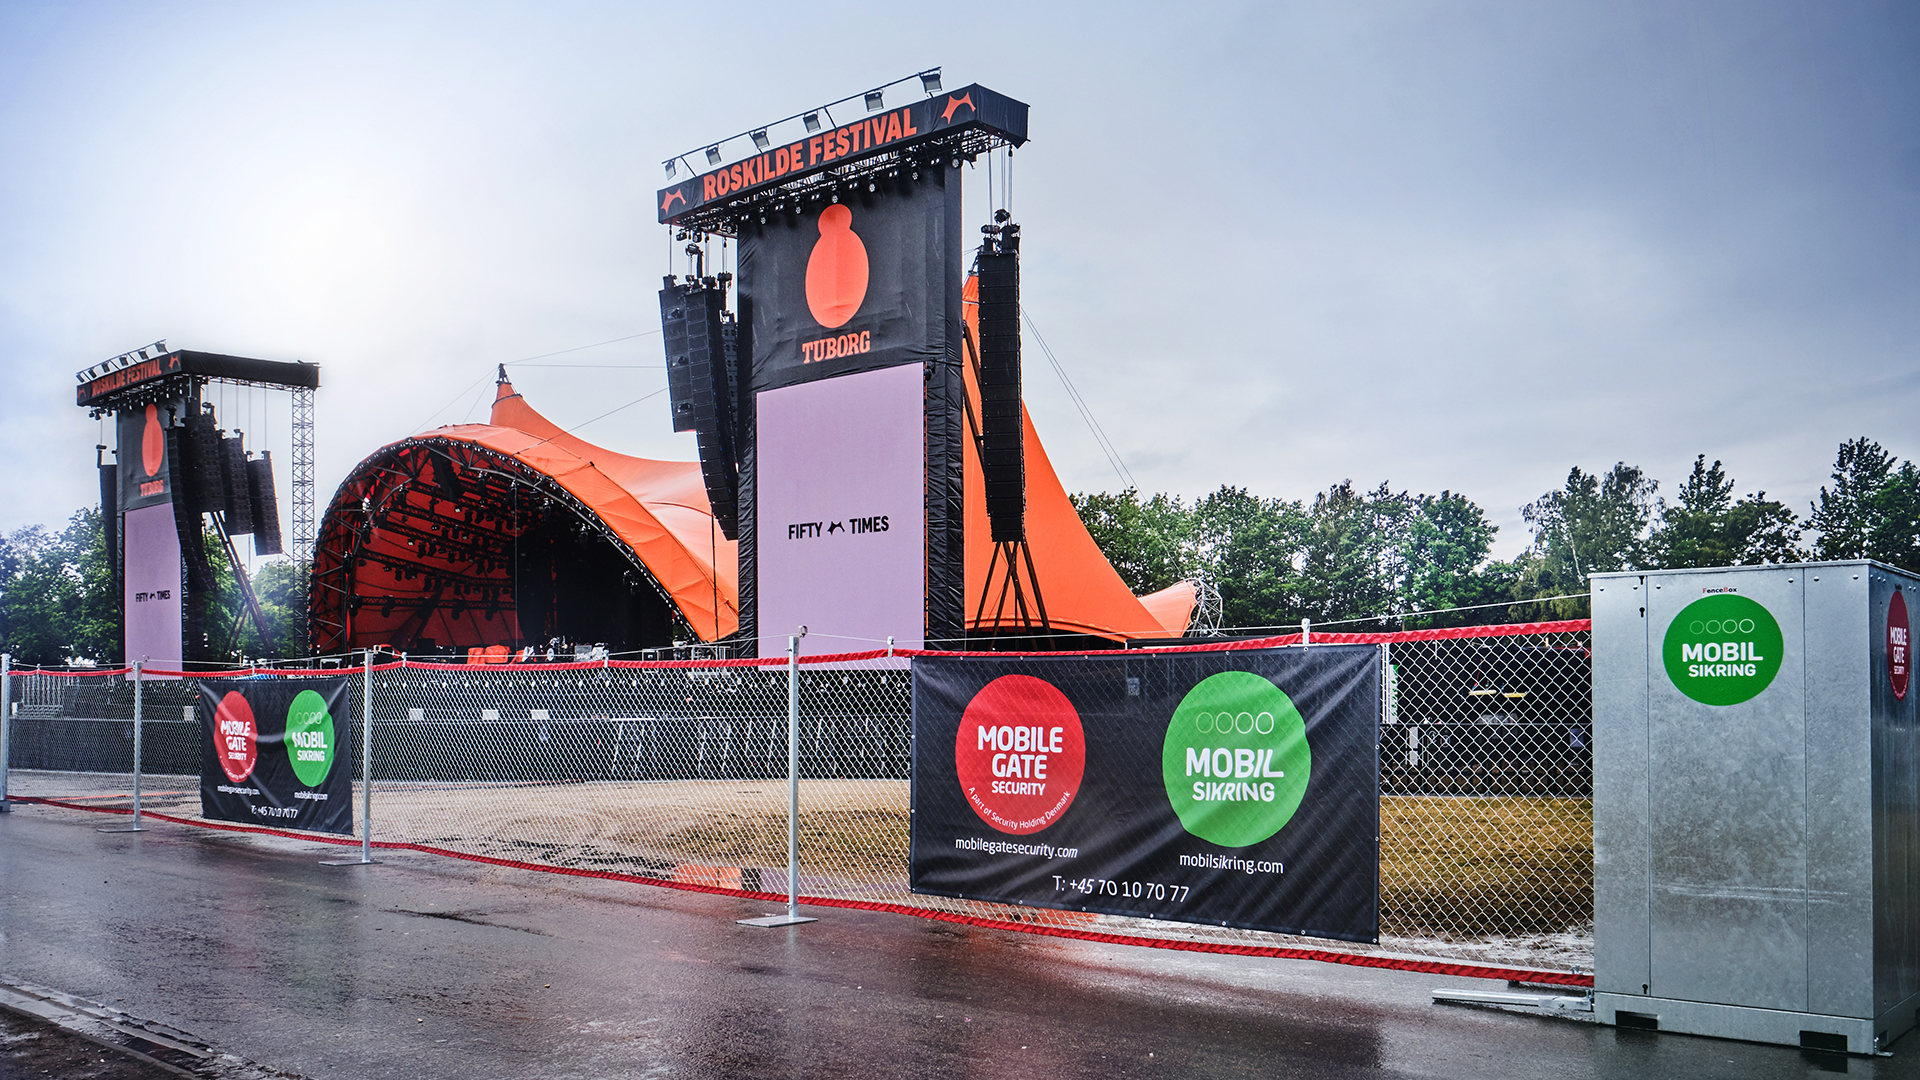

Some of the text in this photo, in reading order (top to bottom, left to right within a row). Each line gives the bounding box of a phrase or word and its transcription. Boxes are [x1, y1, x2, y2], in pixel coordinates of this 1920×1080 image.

[703, 108, 917, 202] ROSKILDE FESTIVAL
[801, 330, 871, 364] TUBORG
[91, 358, 162, 398] ROSKILDE FESTIVAL
[788, 515, 890, 540] FIFTY TIMES
[135, 589, 171, 603] FIFTY TIMES
[1889, 626, 1907, 646] MOBILE
[1682, 641, 1764, 662] MOBIL
[1893, 646, 1905, 664] GATE
[1688, 663, 1757, 678] SIKRING
[220, 720, 251, 736] MOBILE
[977, 725, 1064, 753] MOBILE
[225, 736, 247, 752] GATE
[291, 731, 327, 749] MOBIL
[297, 750, 325, 762] SIKRING
[991, 753, 1048, 779] GATE
[1186, 747, 1285, 779] MOBIL
[991, 780, 1046, 796] SECURITY
[1192, 781, 1276, 803] SIKRING
[968, 786, 1071, 830] A part of Security Holding Denmark
[955, 837, 1079, 860] mobilegatesecurity.com
[1179, 853, 1285, 875] mobilsikring.com
[1052, 875, 1190, 903] T: +45 70 10 70 77
